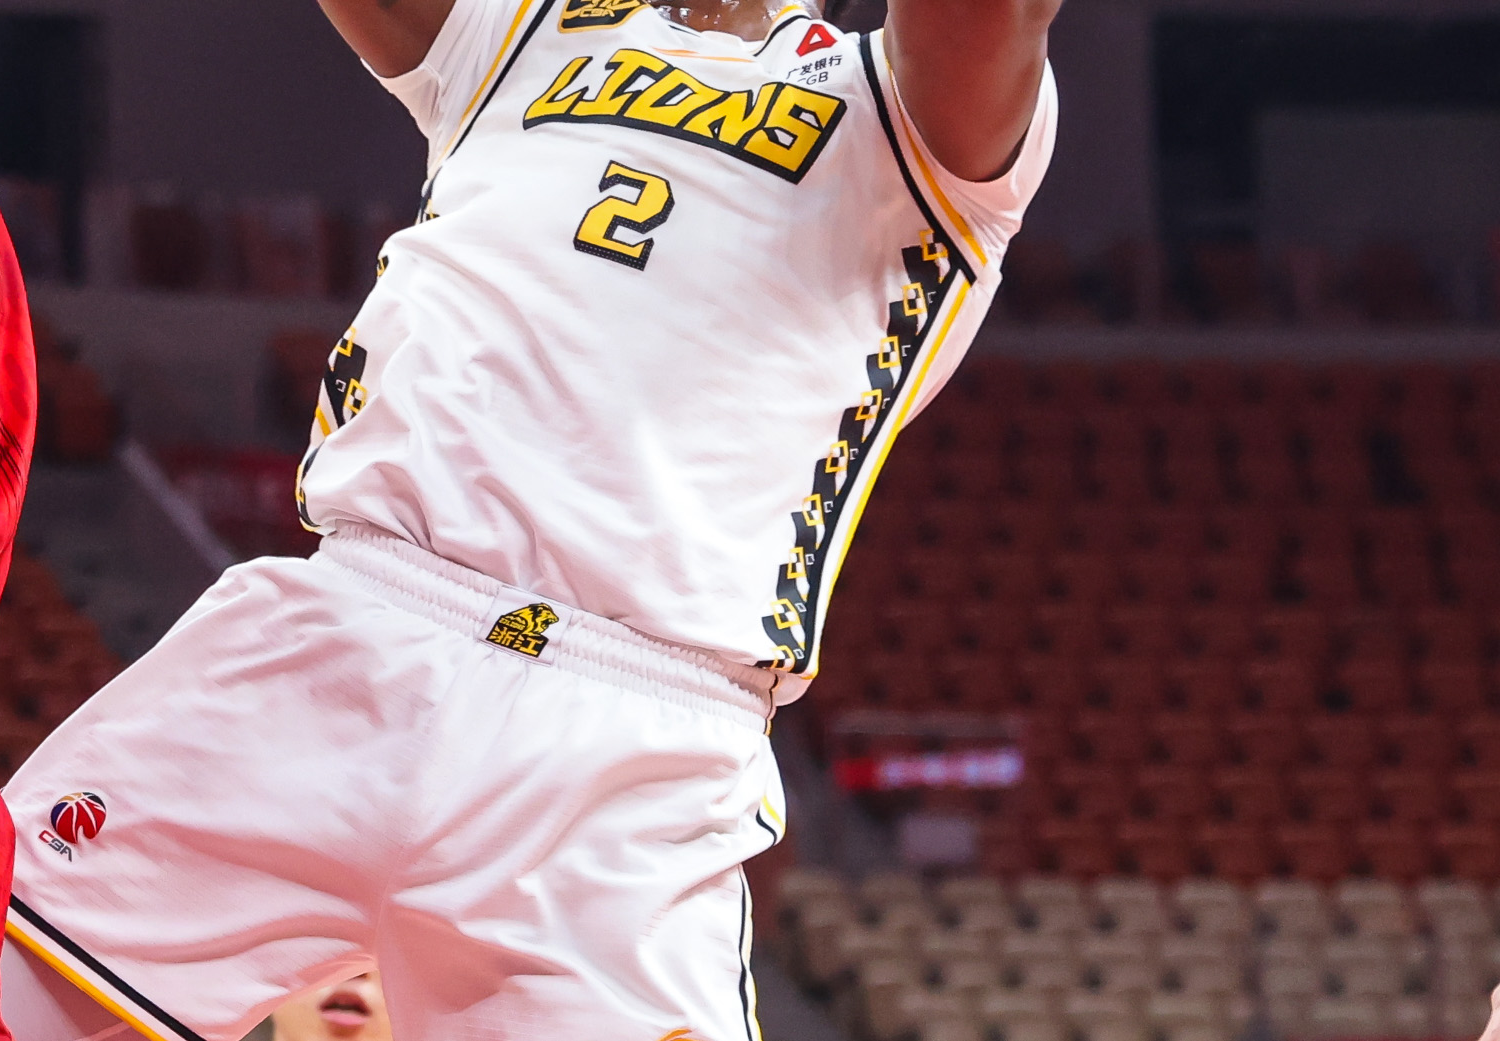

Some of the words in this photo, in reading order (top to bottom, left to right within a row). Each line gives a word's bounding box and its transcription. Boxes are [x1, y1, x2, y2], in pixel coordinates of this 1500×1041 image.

[786, 55, 843, 80] 广发银行
[522, 47, 848, 186] LIONS
[572, 159, 676, 272] 2
[488, 625, 545, 657] 浙江
[38, 829, 73, 863] CBA
